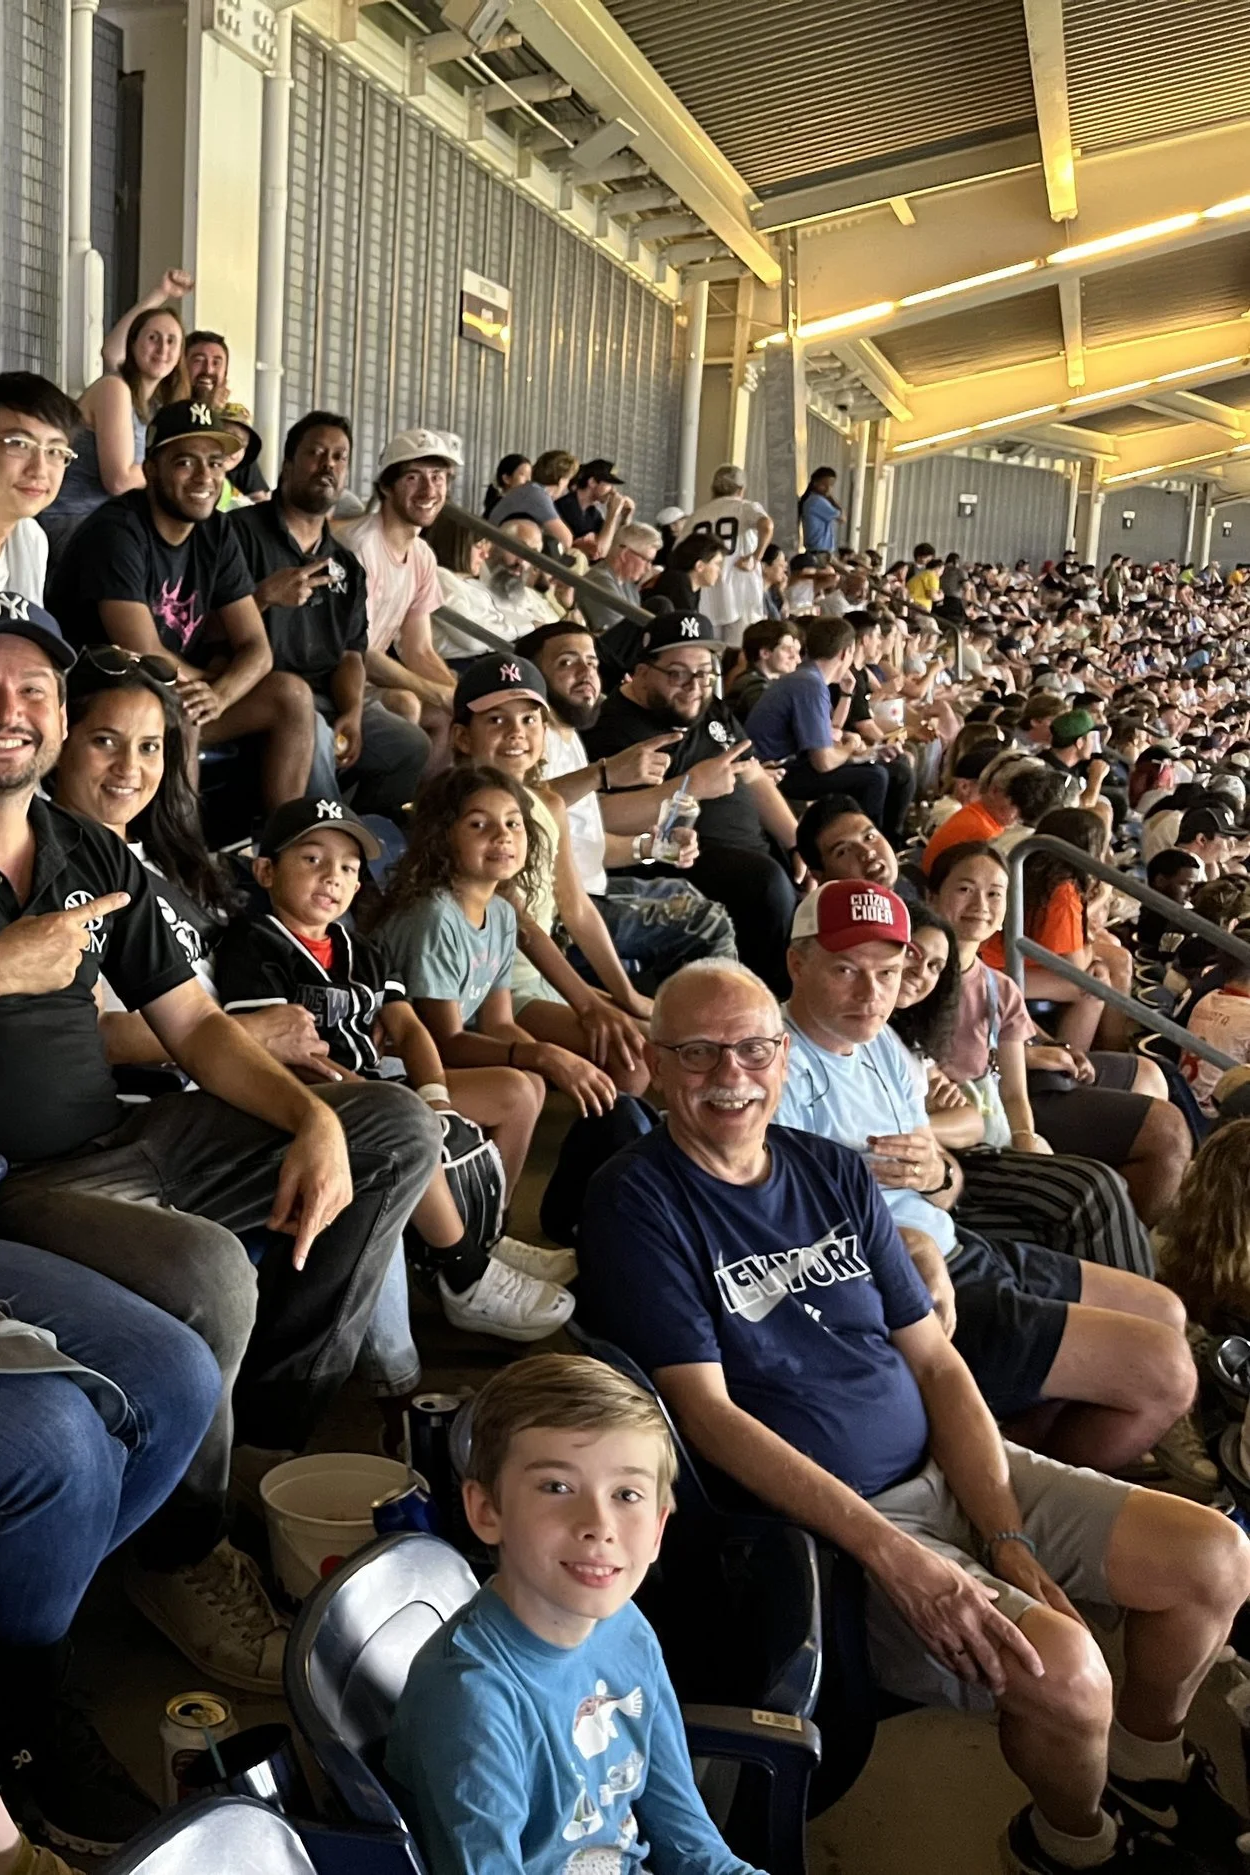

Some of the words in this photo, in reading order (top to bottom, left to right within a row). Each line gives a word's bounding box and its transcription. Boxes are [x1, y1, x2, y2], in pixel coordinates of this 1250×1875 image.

[190, 403, 212, 425] NY
[681, 617, 700, 638] NY
[500, 663, 522, 682] NY
[316, 799, 343, 819] NY
